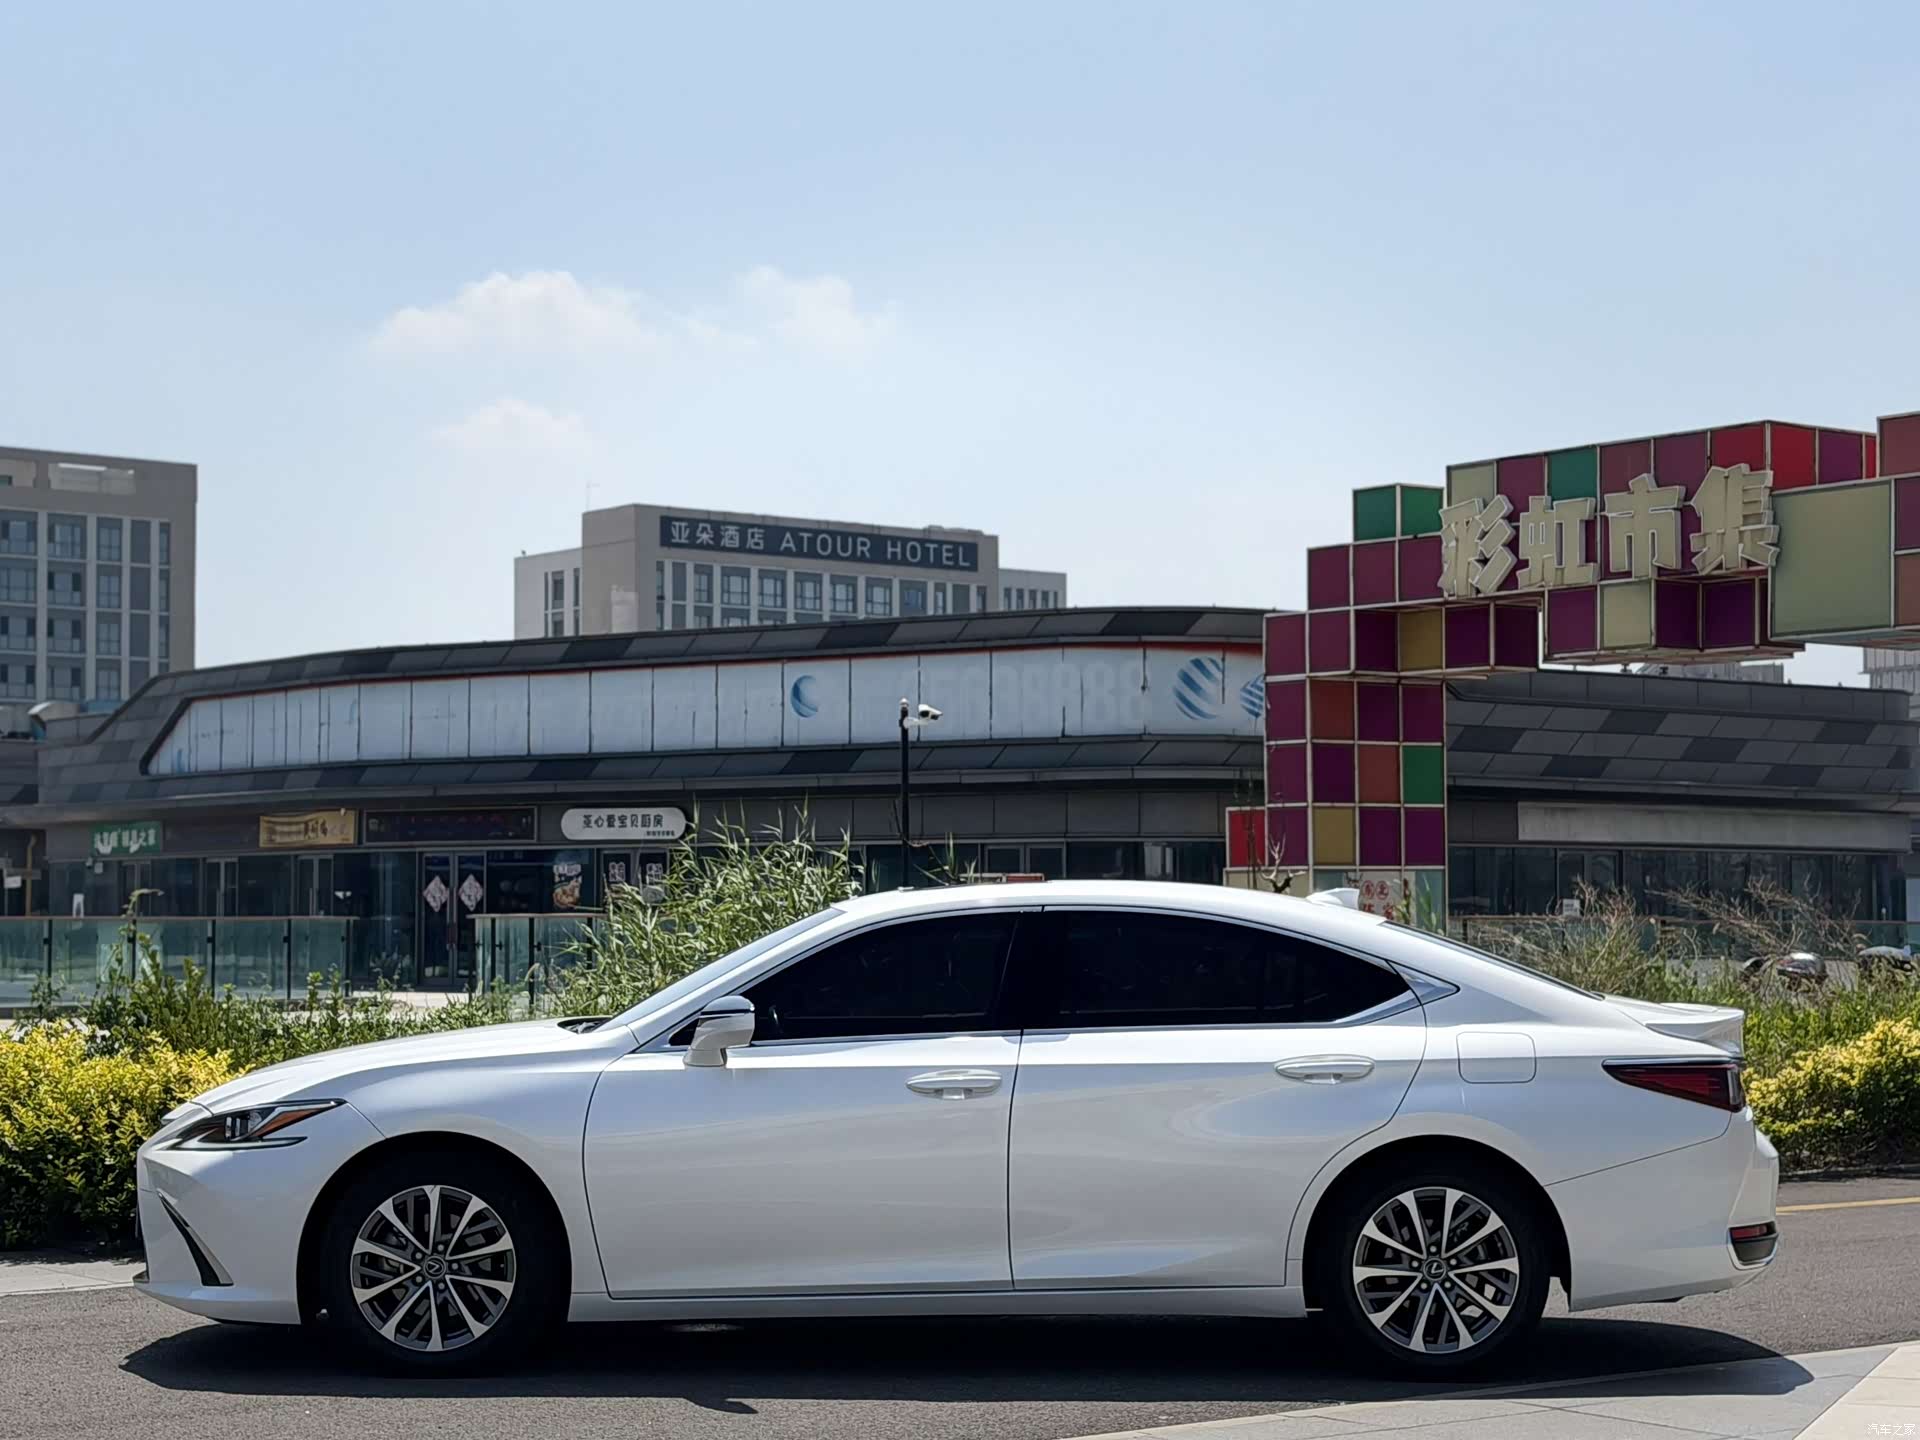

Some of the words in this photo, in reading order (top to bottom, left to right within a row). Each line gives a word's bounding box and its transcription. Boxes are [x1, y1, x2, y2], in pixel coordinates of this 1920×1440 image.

[671, 521, 765, 550] 亚朵酒店
[780, 531, 871, 559] ATOUR
[887, 540, 970, 567] HOTEL
[1438, 463, 1780, 598] 彩虹市集
